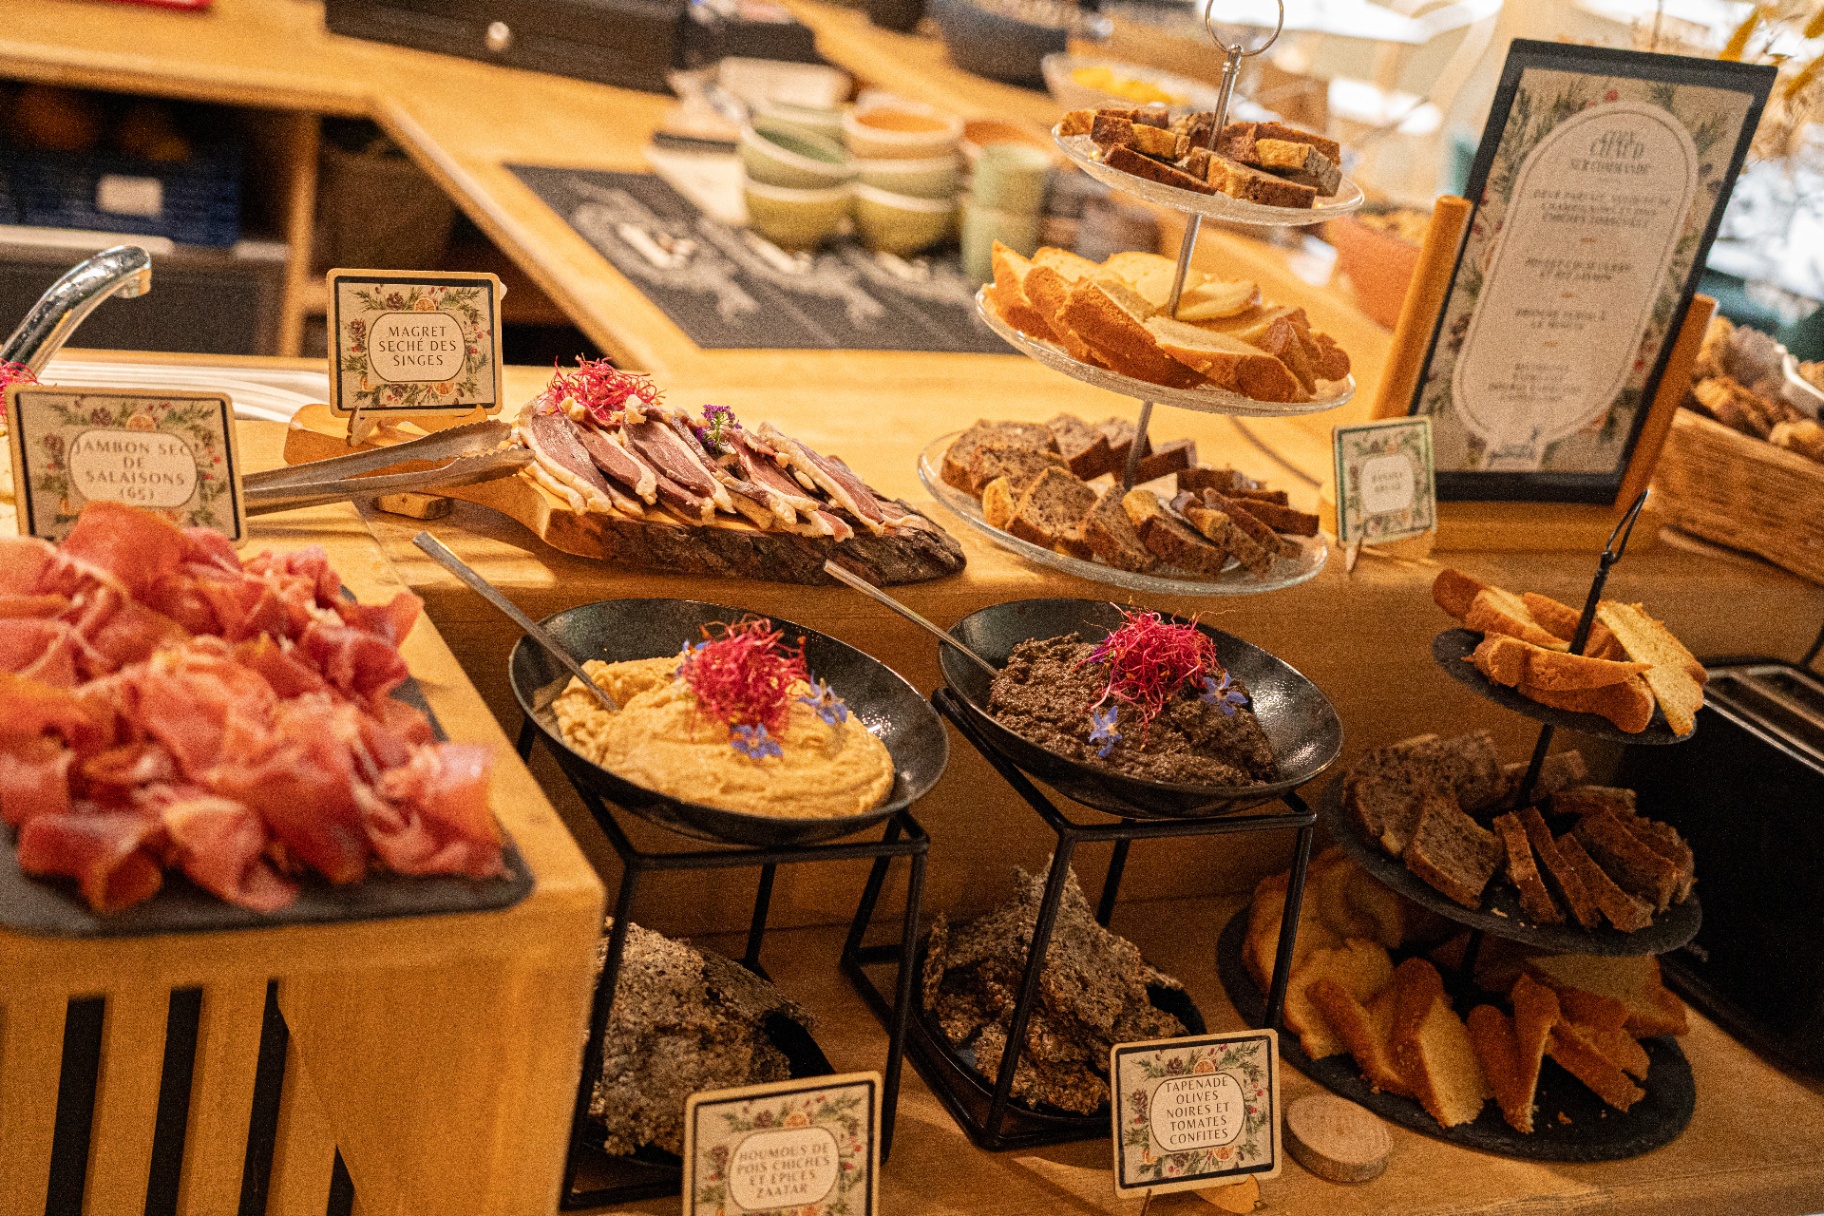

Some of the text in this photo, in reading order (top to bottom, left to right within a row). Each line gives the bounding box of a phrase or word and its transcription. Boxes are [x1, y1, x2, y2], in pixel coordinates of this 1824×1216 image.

[388, 326, 447, 337] MAGRET
[430, 340, 457, 352] DES
[393, 355, 444, 366] SINGES
[75, 440, 150, 454] JAMBON
[123, 457, 145, 468] DE
[85, 470, 185, 485] SALAISONS
[1165, 1076, 1228, 1093] TAPENADE
[1176, 1090, 1219, 1104] OLIVES
[1167, 1102, 1230, 1118] NOIRES ET
[1170, 1115, 1227, 1131] TOMATES
[1169, 1128, 1228, 1145] CONFITES
[739, 1142, 830, 1161] HOUMOUS DE
[737, 1155, 830, 1174] POIS CHICHES
[749, 1175, 764, 1186] ET
[756, 1183, 807, 1199] ZAATAR
